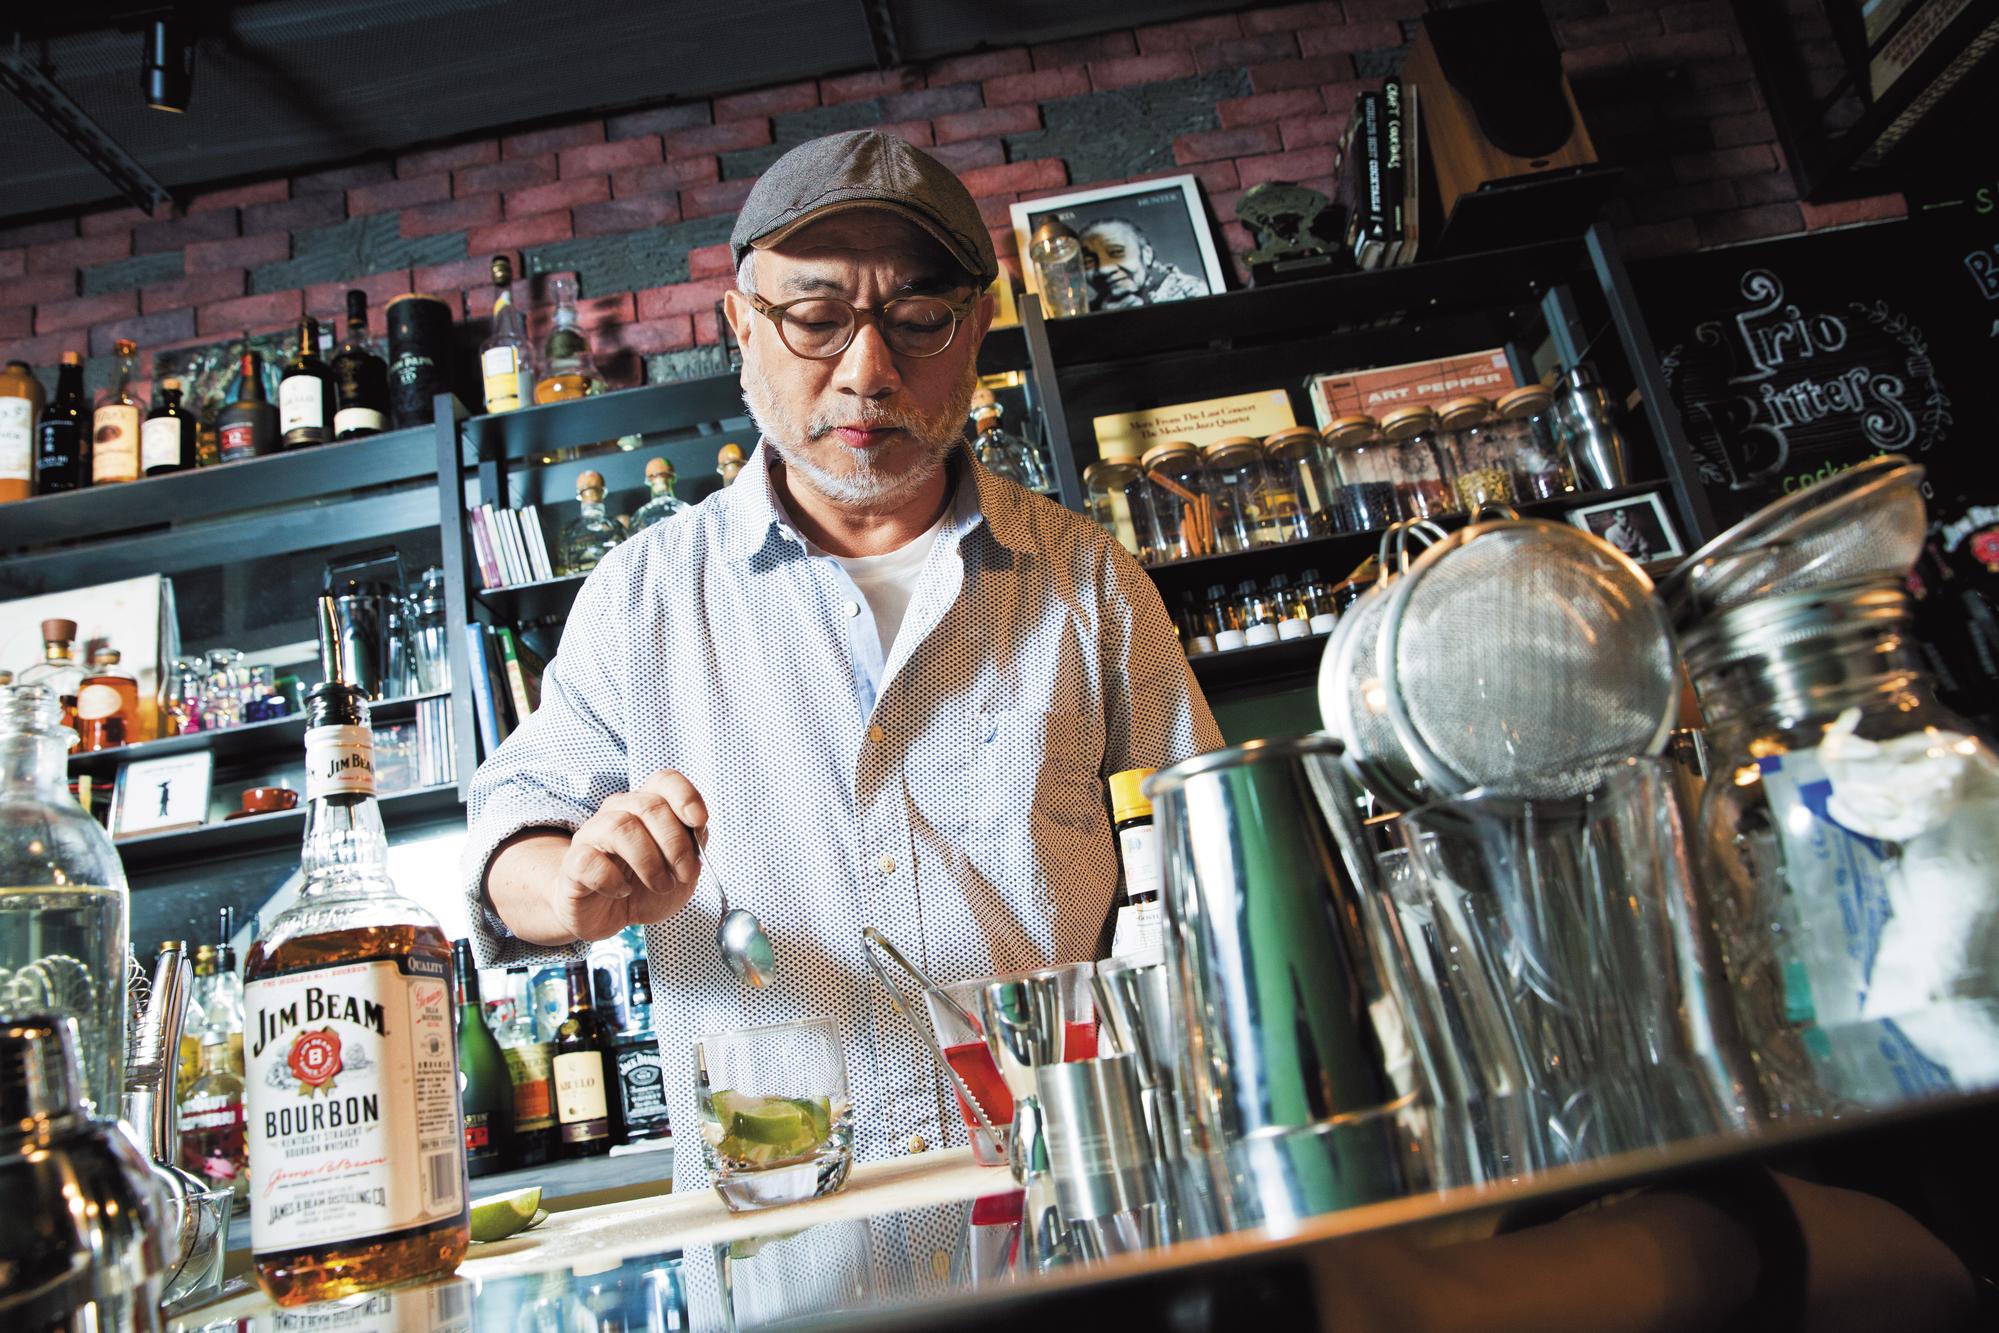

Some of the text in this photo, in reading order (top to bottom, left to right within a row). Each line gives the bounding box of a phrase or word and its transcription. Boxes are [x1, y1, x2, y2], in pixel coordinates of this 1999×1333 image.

[1696, 268, 1848, 386] Trio
[1368, 373, 1502, 404] ART PEPPER
[1130, 419, 1153, 430] More
[1155, 415, 1182, 426] From
[1183, 412, 1200, 422] The
[1142, 414, 1251, 440] The Modern Jazz Quartet
[1696, 366, 1917, 491] Bitters
[327, 757, 350, 779] JIM
[407, 956, 444, 975] QUALITY
[253, 1002, 299, 1059] JIM
[306, 986, 386, 1038] BEAM
[308, 1047, 323, 1066] B
[265, 1093, 379, 1139] BOURBON
[282, 1126, 362, 1147] KENTUCKY STRAIGHT
[285, 1138, 360, 1159] BOURBON WHISKEY
